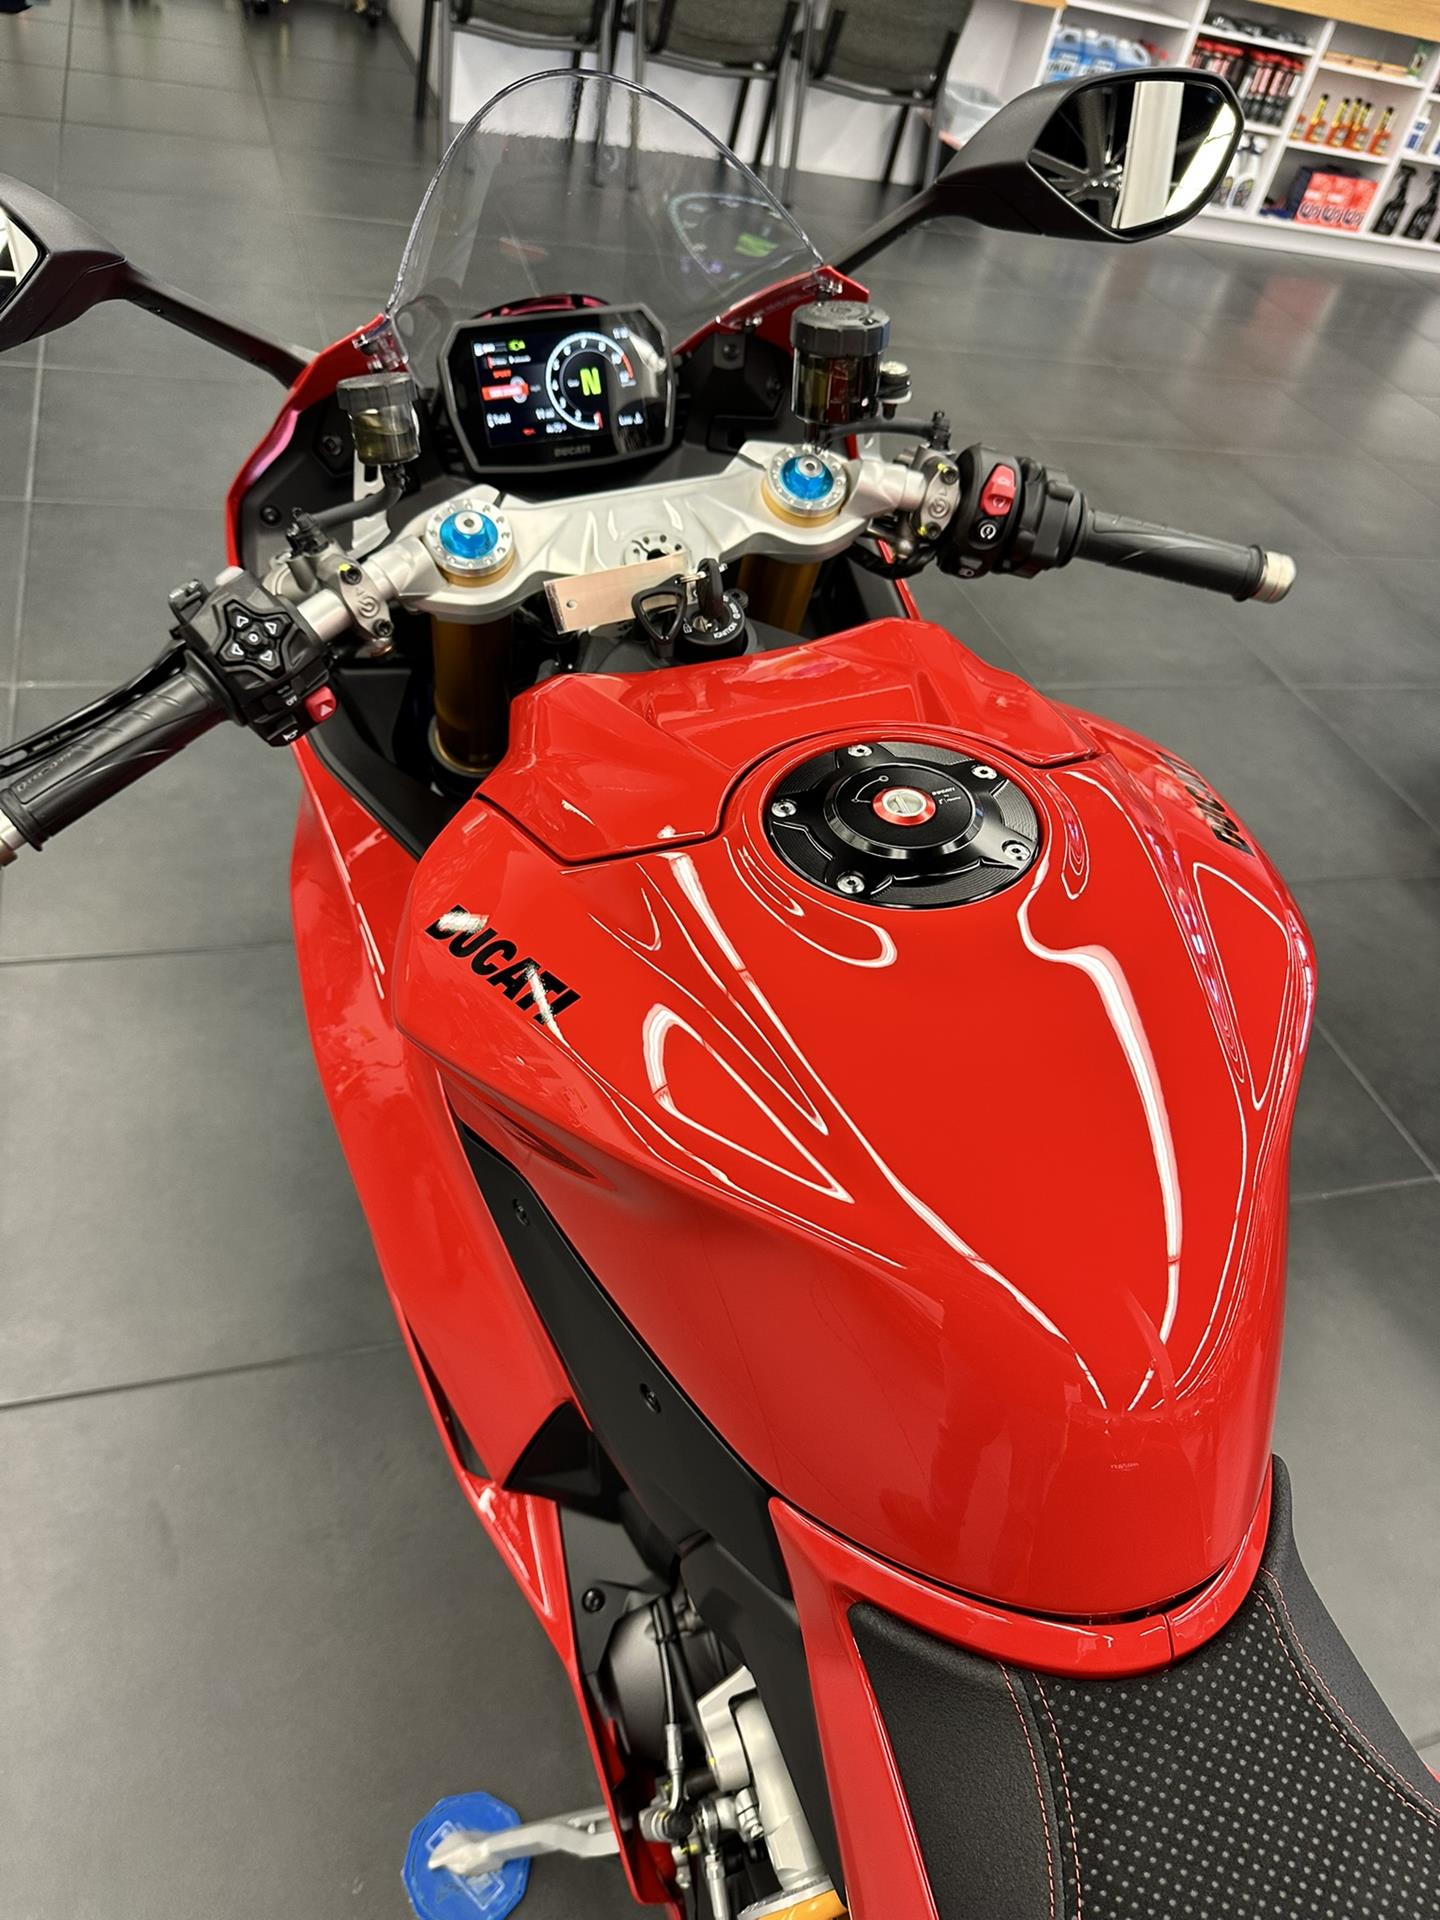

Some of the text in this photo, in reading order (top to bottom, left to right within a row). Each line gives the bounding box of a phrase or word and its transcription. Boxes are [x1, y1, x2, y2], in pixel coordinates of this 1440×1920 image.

[580, 367, 602, 396] N
[554, 444, 591, 457] DUCATI
[425, 904, 582, 1025] DUCATI
